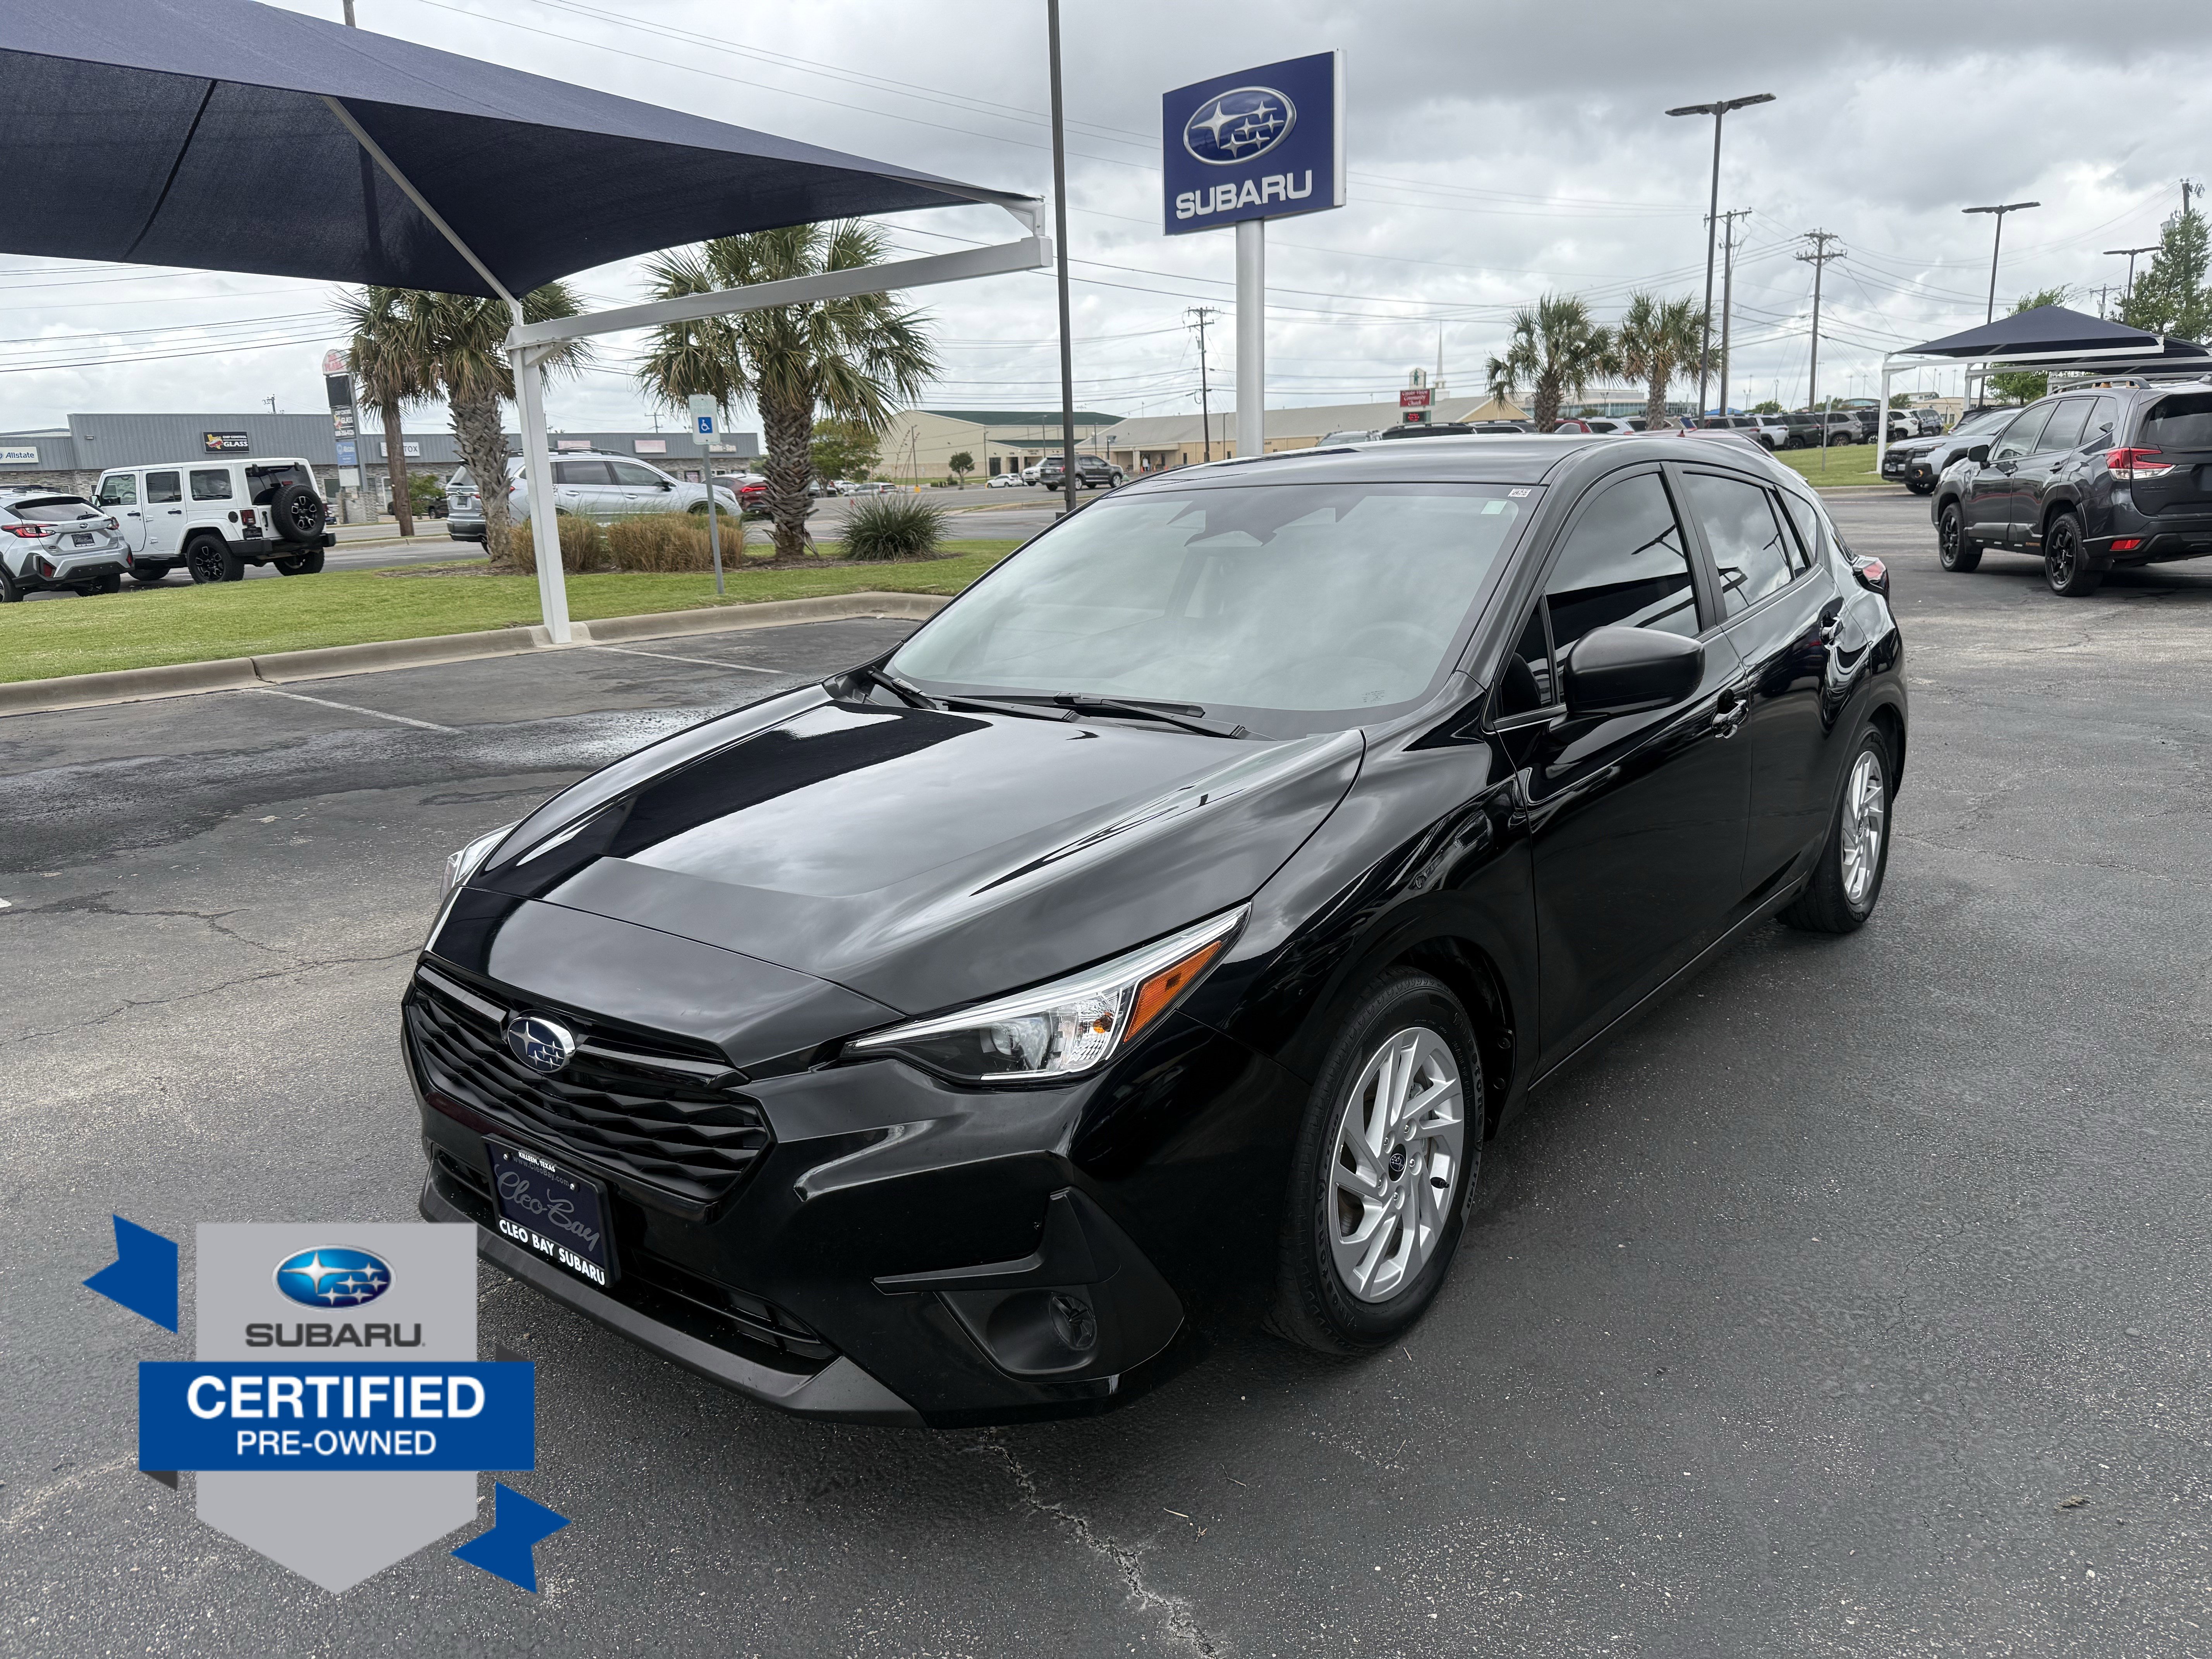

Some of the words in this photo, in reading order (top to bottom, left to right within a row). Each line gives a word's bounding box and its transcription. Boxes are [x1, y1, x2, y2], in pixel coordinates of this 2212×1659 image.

[1176, 170, 1312, 220] SUBARU
[518, 1151, 539, 1166] KILLEEN,
[539, 1160, 556, 1173] TEXAS
[494, 1164, 548, 1214] Cleo
[546, 1188, 600, 1252] Bay
[499, 1219, 528, 1243] CLEO
[532, 1233, 555, 1256] BAY
[558, 1247, 605, 1285] SUBARU
